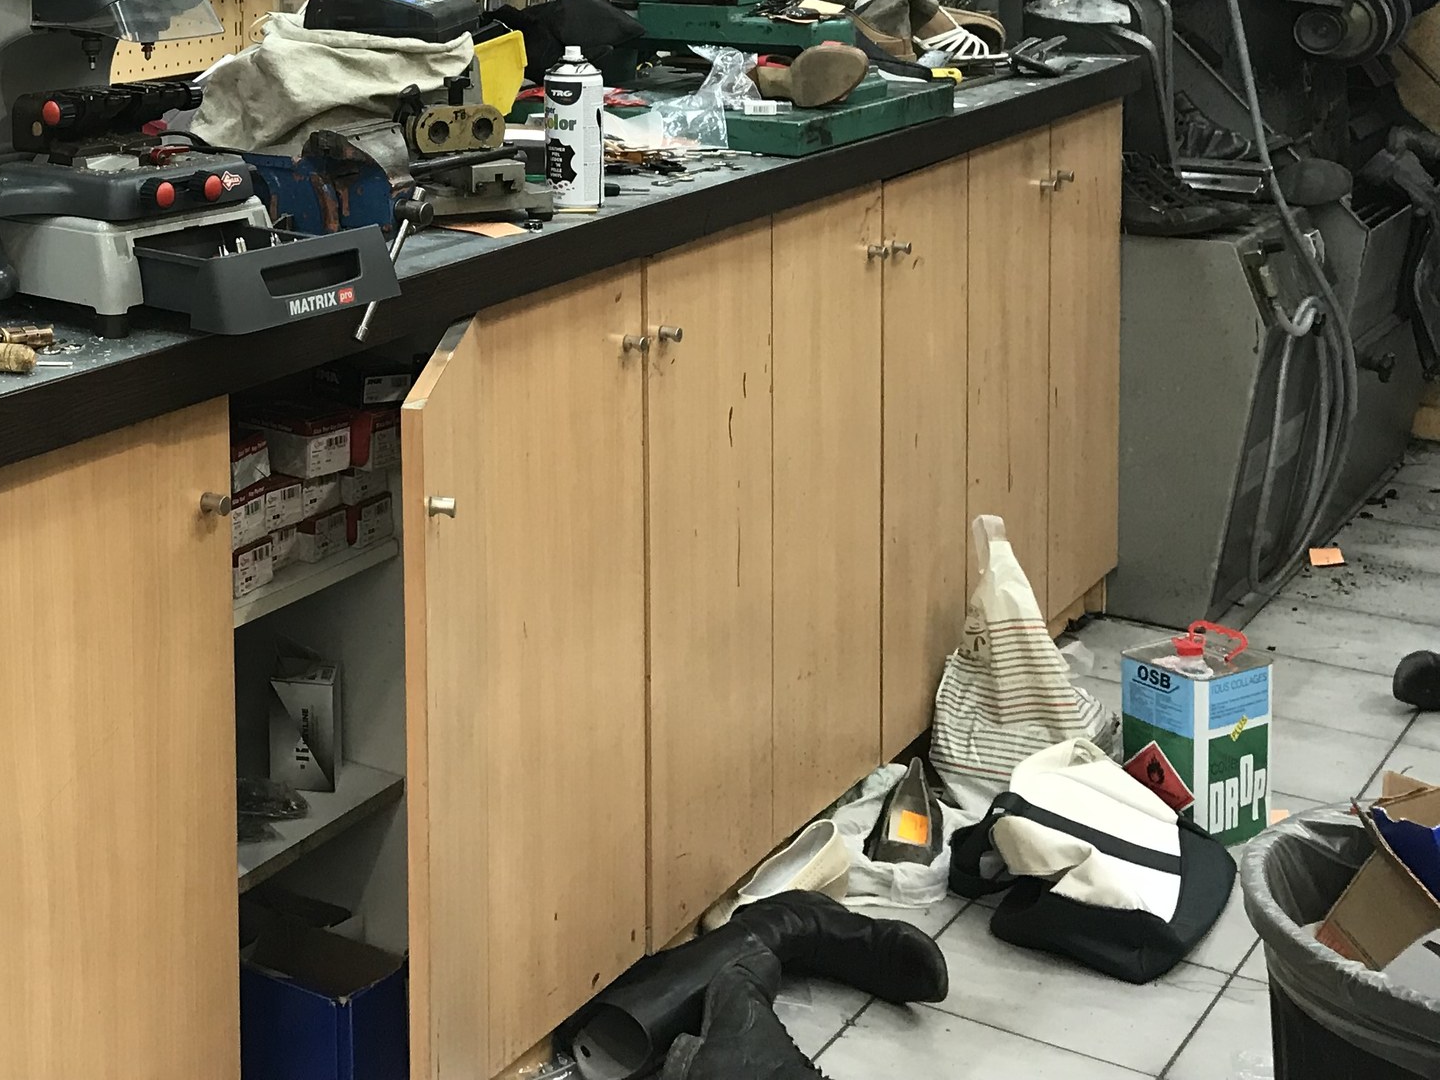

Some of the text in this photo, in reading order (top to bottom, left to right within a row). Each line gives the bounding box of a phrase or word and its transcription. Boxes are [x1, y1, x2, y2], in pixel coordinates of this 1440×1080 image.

[550, 89, 573, 98] TRG
[289, 289, 353, 316] MATRIX pro
[1137, 665, 1171, 689] OSB
[1211, 672, 1268, 695] TOUS COLLAGES
[1209, 753, 1266, 835] DROP
